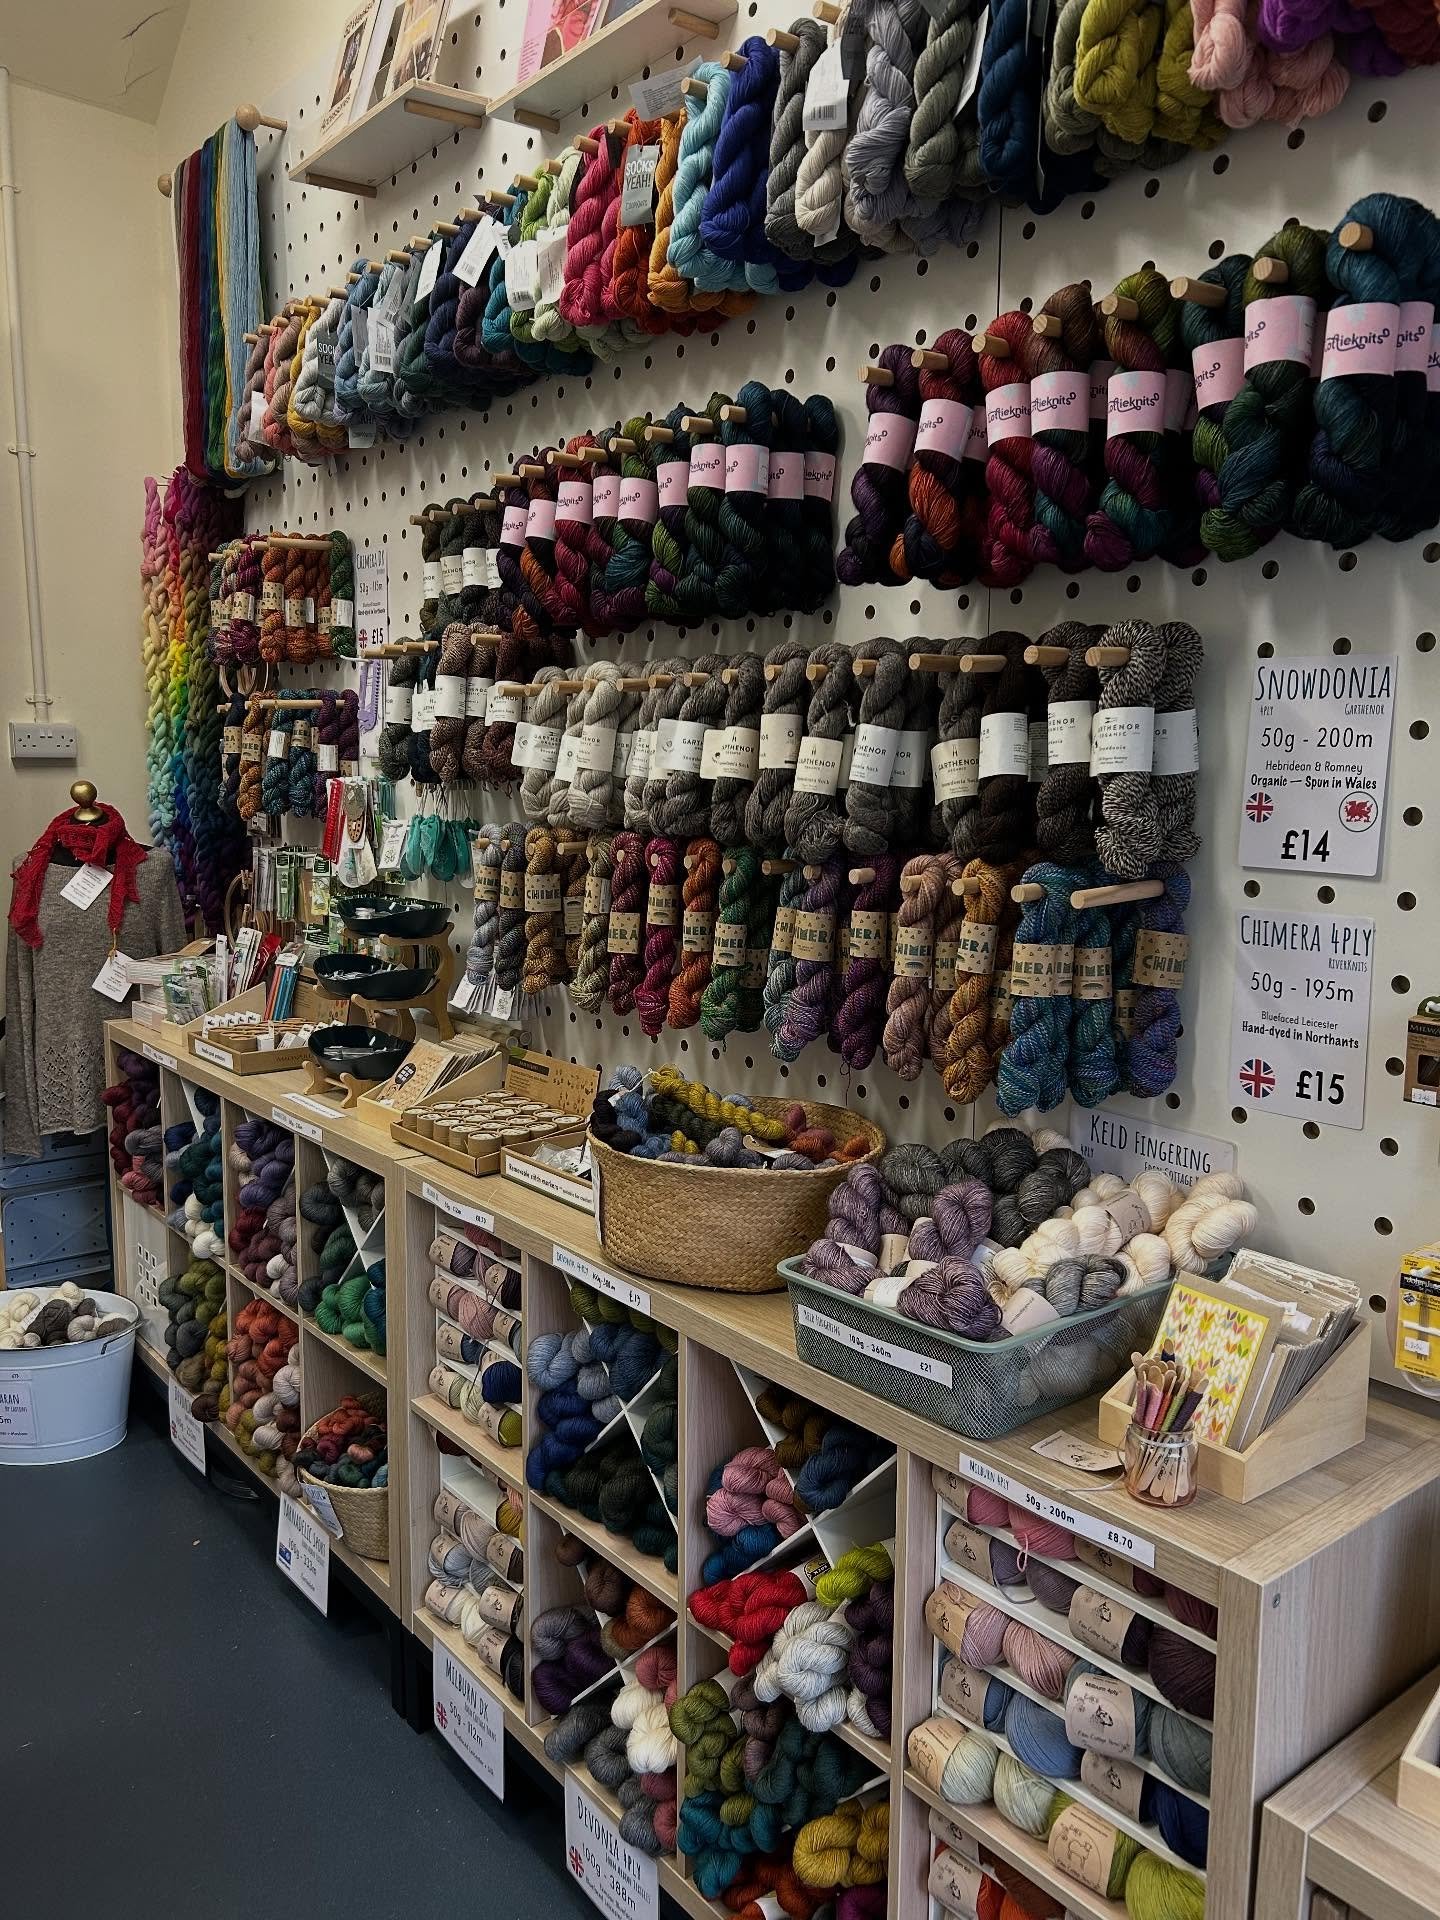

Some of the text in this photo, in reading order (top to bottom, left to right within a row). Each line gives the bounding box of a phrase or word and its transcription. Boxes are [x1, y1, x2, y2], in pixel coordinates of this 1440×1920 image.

[626, 160, 655, 176] SOCKS
[626, 174, 652, 191] YEAH!
[372, 628, 384, 645] £15
[1255, 666, 1390, 701] SNOWDONIA
[1260, 704, 1384, 716] 4PLY GARTHENOR
[1261, 727, 1295, 752] 50g
[1317, 727, 1372, 748] 200m
[1266, 760, 1363, 776] Hebridean & Romney
[1250, 774, 1288, 788] Organic
[1305, 776, 1329, 790] Spun
[1332, 776, 1342, 788] in
[1345, 777, 1377, 790] Wales
[1281, 830, 1330, 862] £14
[1241, 916, 1372, 957] CHIMERA 4PLY
[1328, 958, 1368, 973] RIVERKNITS
[1250, 972, 1283, 999] 50g
[1306, 978, 1354, 1002] 195m
[1261, 1010, 1338, 1030] Bluefaced Leicester
[1242, 1021, 1359, 1049] Hand-dyed in Northants
[1296, 1070, 1345, 1104] £15
[1090, 1114, 1211, 1174] KELD FINGERING
[849, 1334, 864, 1350] 100g
[871, 1344, 892, 1358] 360m
[920, 1362, 932, 1373] £21
[1026, 1494, 1041, 1511] 50g
[1050, 1506, 1075, 1524] 200m
[1108, 1531, 1133, 1550] £8.70
[445, 1657, 489, 1722] MILBURN DK
[450, 1702, 461, 1726] 50g
[468, 1721, 483, 1748] 112m
[578, 1796, 641, 1881] DEVONIA 4PLY
[582, 1842, 601, 1878] 100g
[610, 1875, 636, 1911] 388m
